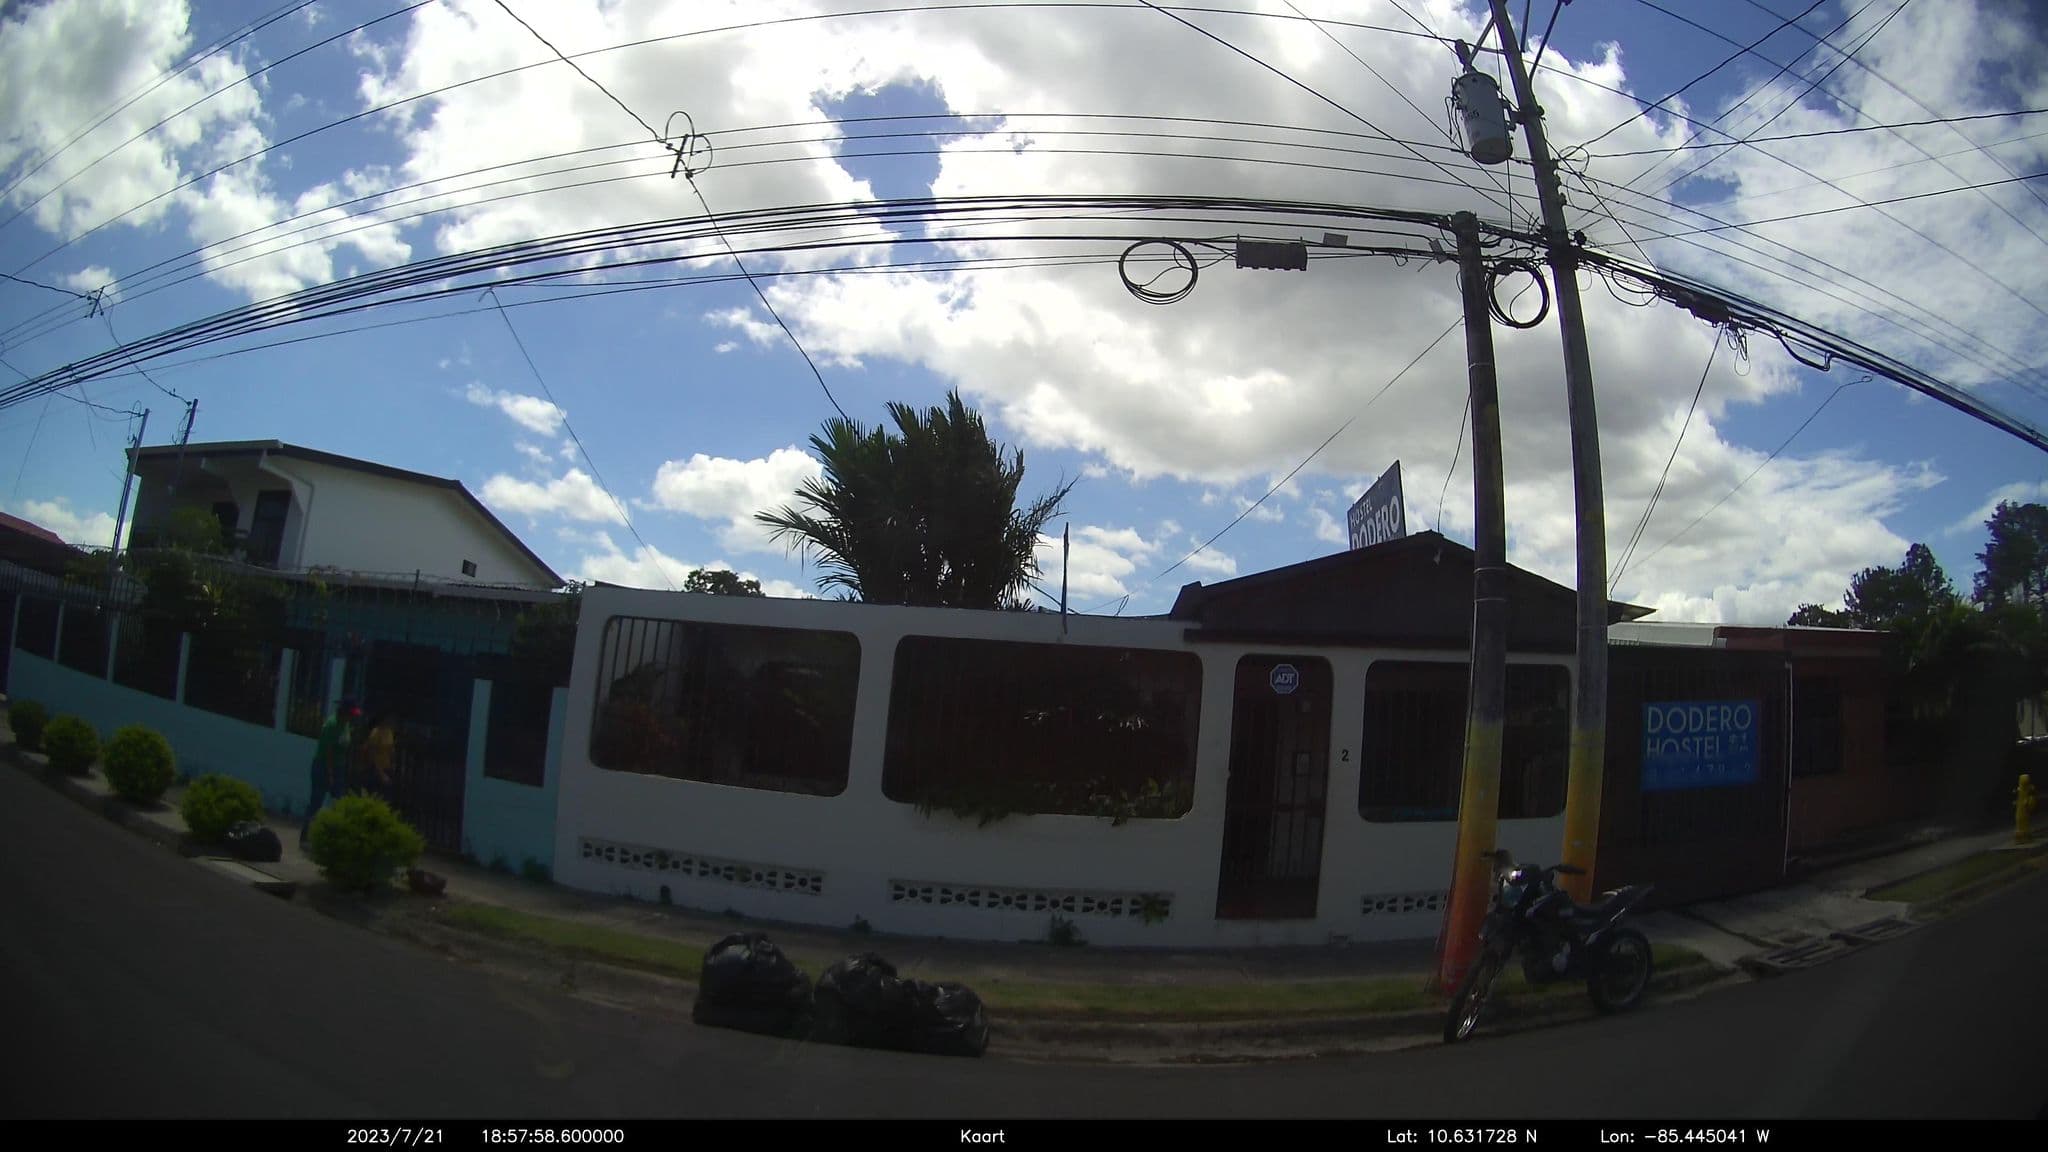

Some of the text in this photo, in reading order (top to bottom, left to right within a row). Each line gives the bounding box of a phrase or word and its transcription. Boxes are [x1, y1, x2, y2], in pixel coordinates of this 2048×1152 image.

[1351, 495, 1400, 549] DODERO
[1274, 672, 1295, 684] ADT
[1647, 703, 1752, 734] DODERO
[1341, 749, 1350, 762] 2
[1646, 735, 1720, 760] HOSTEL
